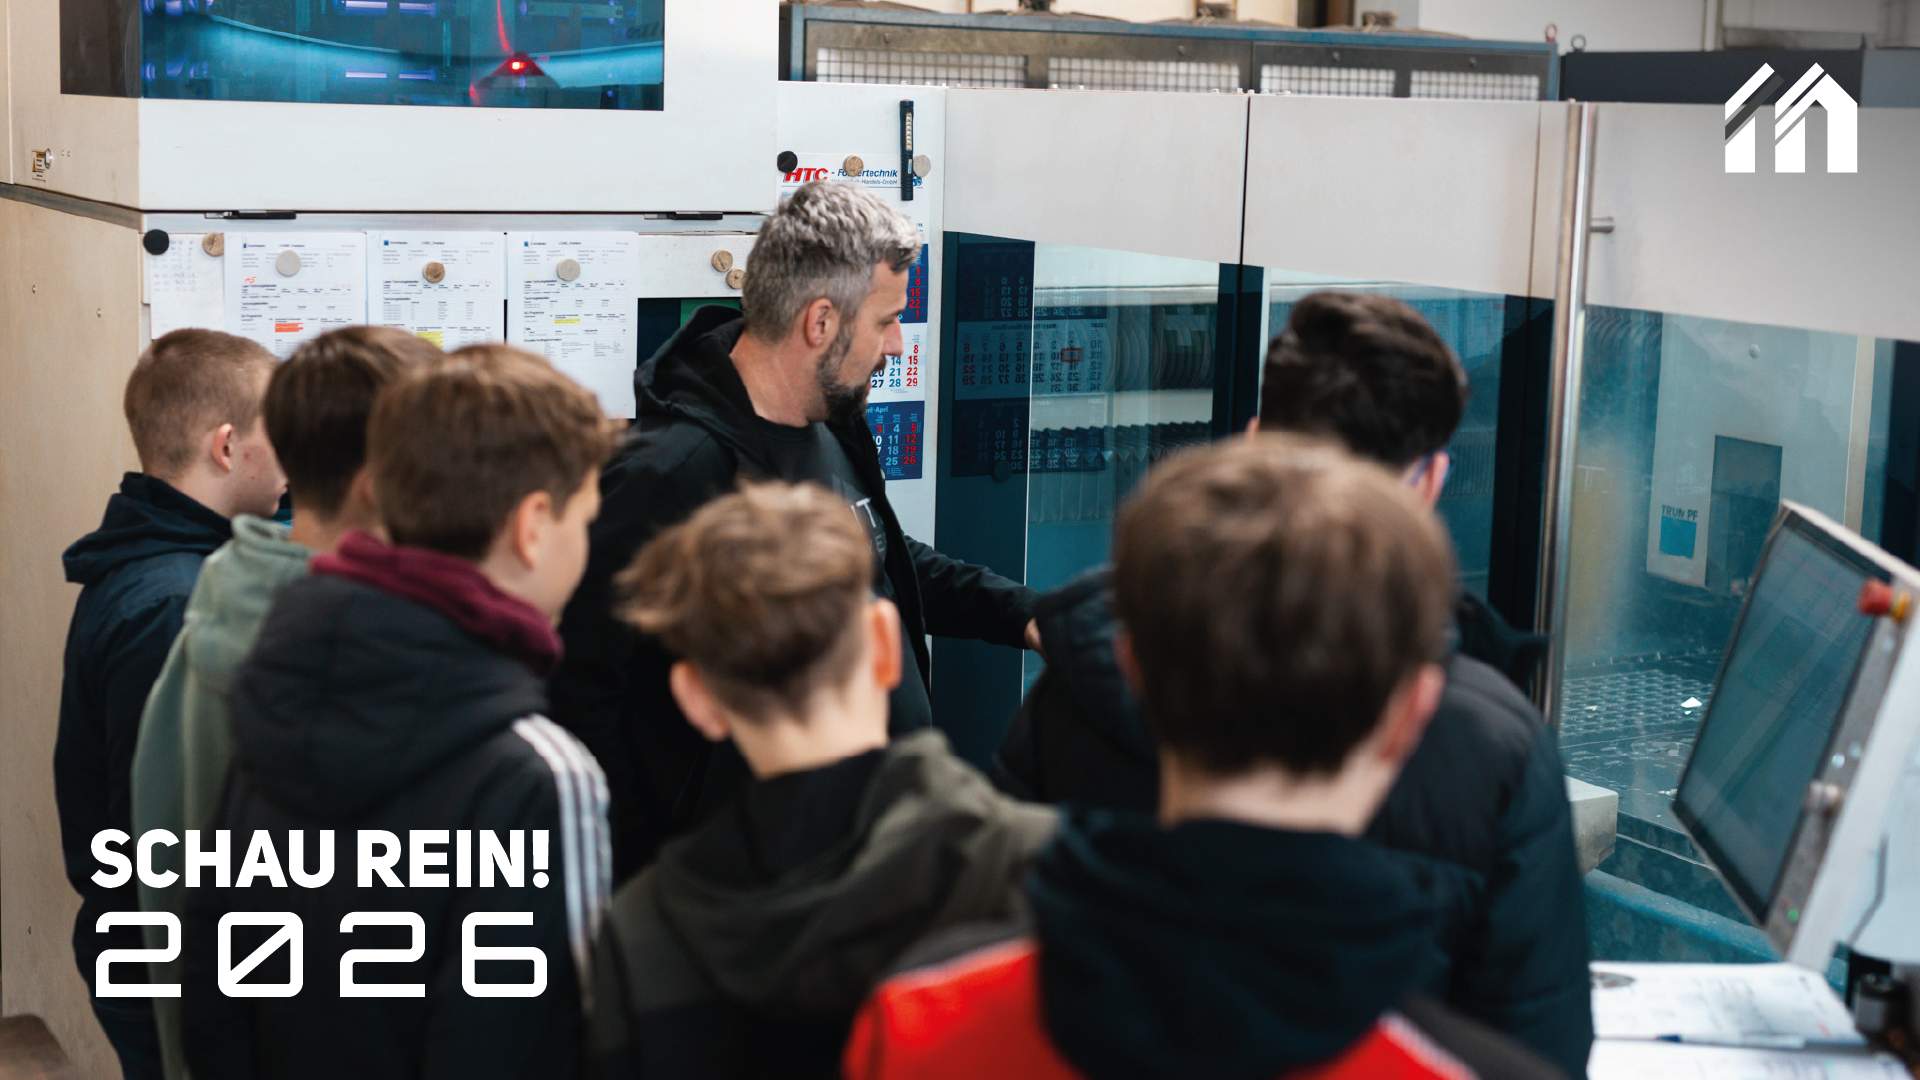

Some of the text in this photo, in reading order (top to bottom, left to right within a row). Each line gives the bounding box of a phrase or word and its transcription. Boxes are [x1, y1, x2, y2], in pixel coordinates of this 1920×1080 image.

[784, 167, 829, 183] HTC
[838, 168, 898, 177] Fertechnik
[913, 344, 919, 354] 8
[907, 355, 918, 365] 15
[889, 368, 901, 377] 21
[906, 367, 918, 376] 22
[871, 377, 918, 388] 27 28 29
[893, 424, 899, 433] 4
[887, 435, 898, 445] 11
[887, 446, 899, 455] 18
[886, 457, 899, 466] 25
